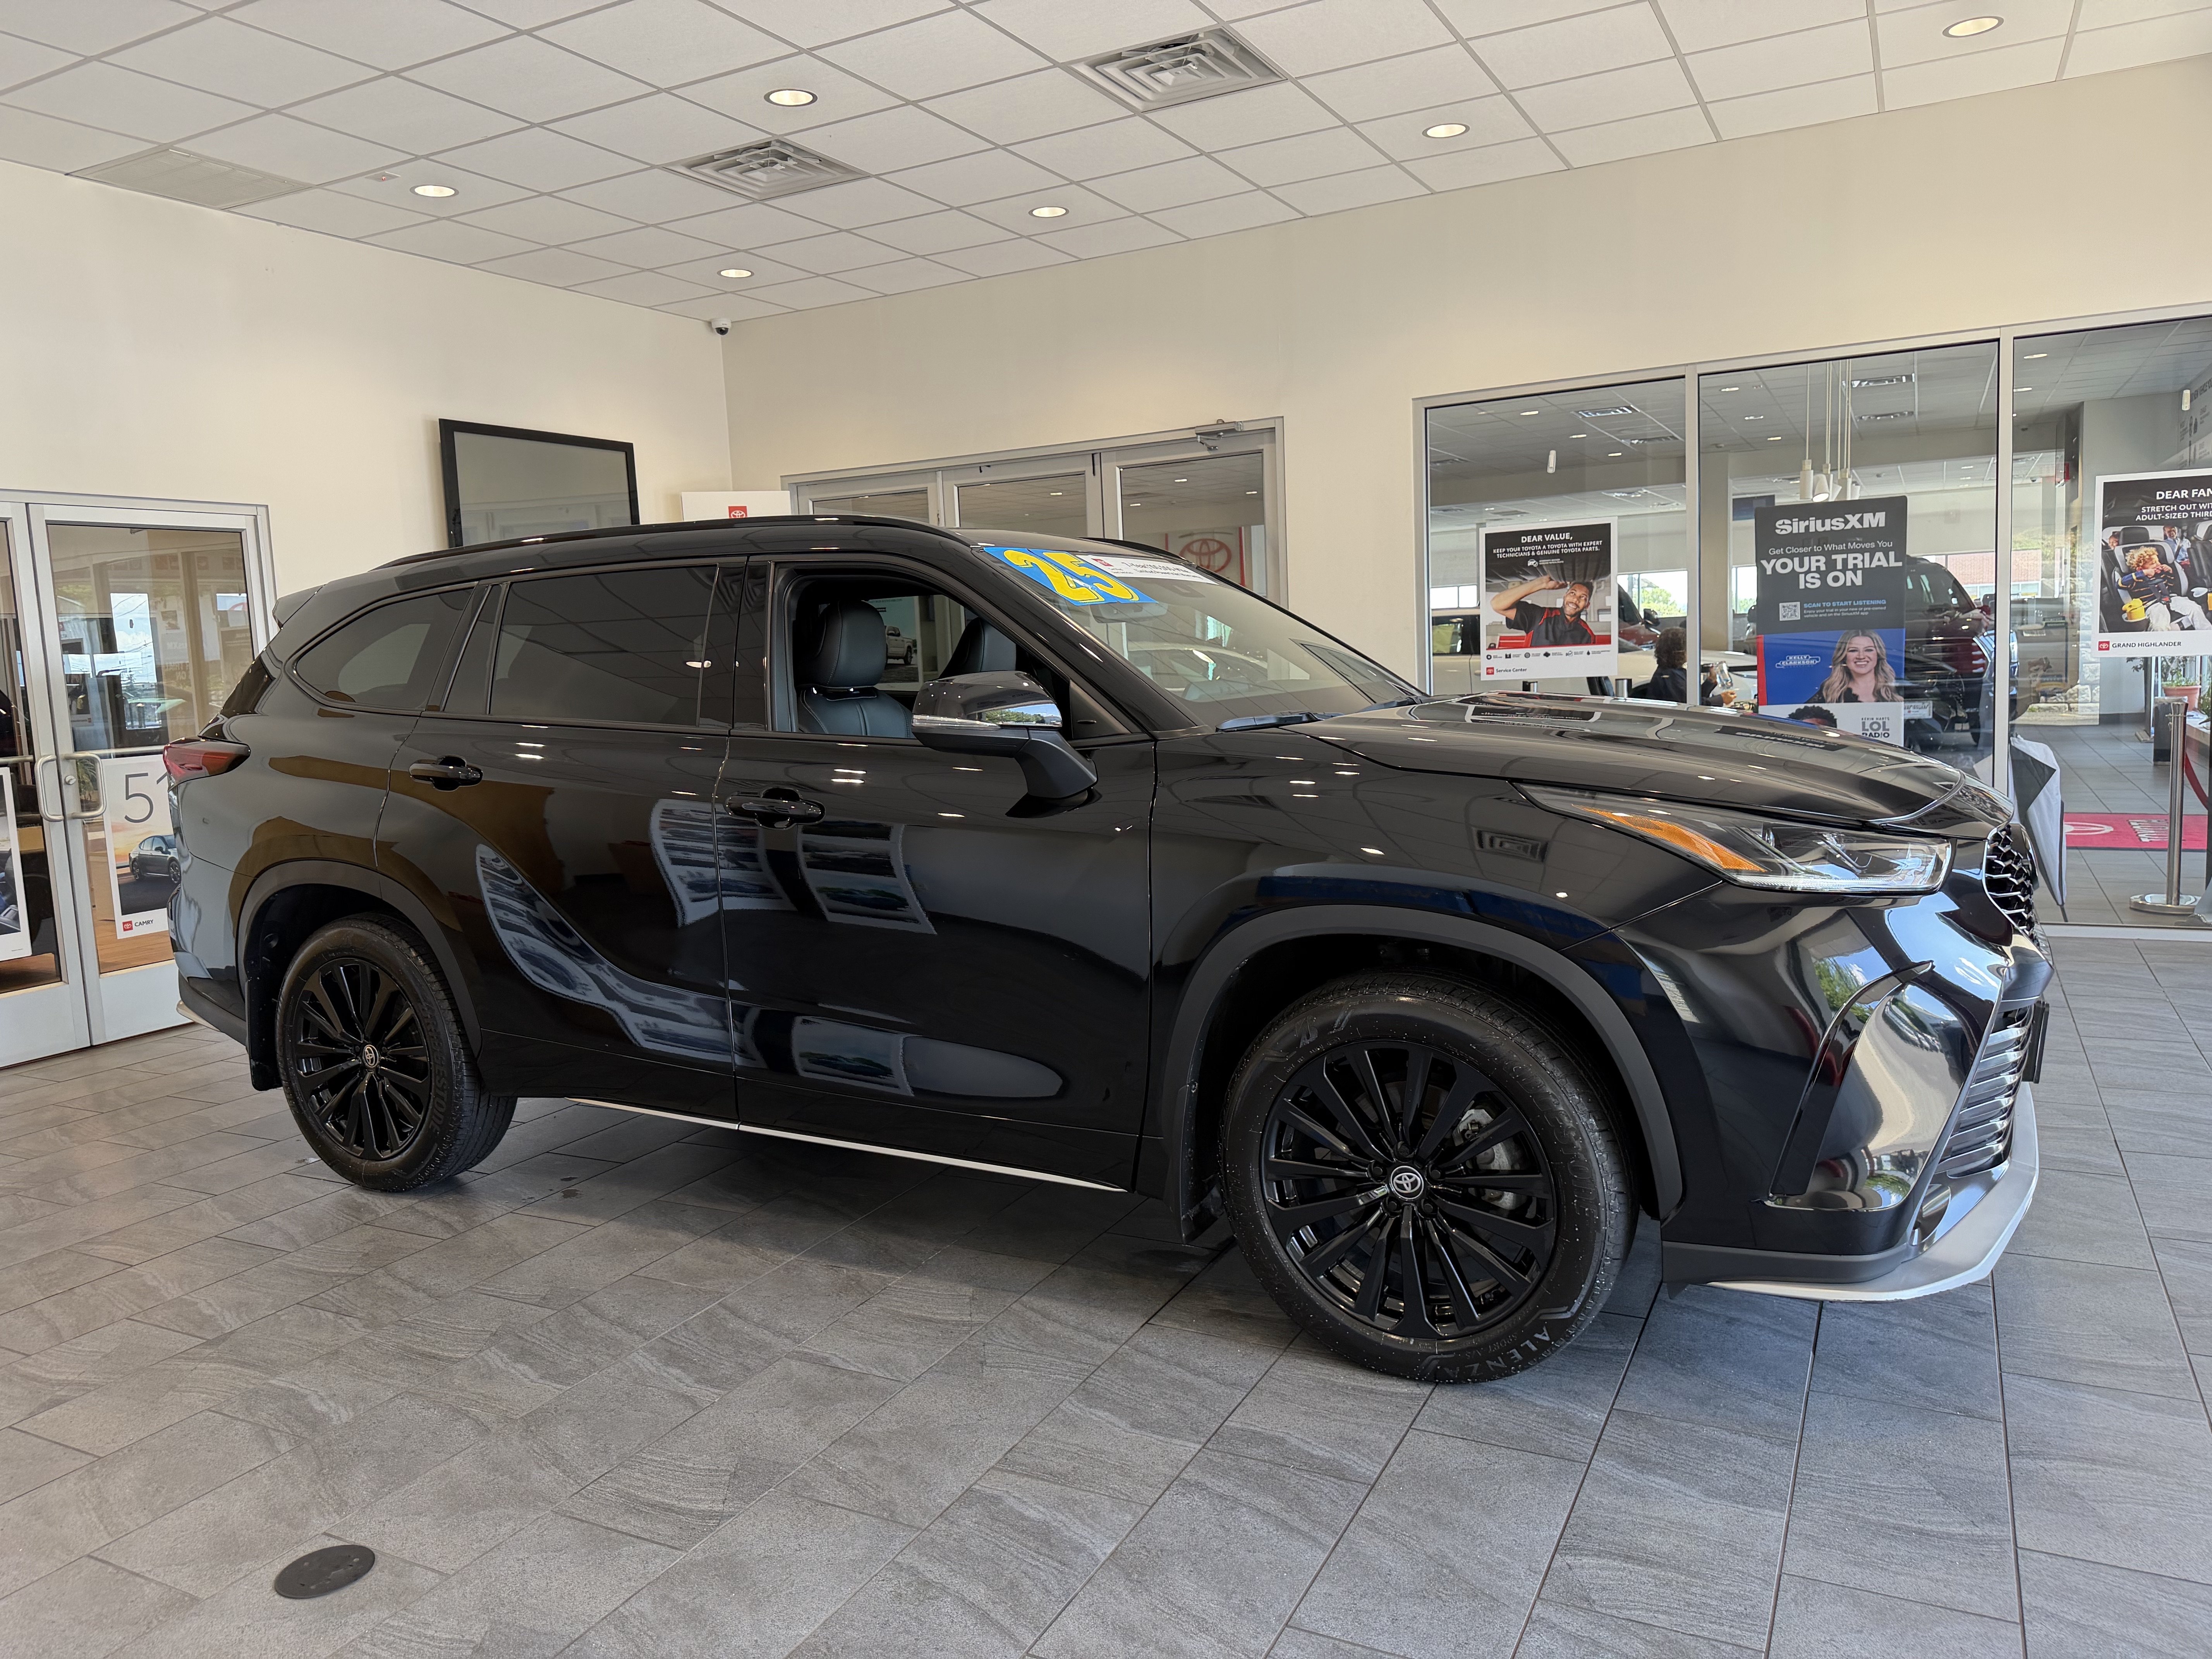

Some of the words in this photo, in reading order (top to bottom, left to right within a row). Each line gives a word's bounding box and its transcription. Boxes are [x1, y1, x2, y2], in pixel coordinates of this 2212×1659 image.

[2156, 490, 2188, 500] DEAR
[2142, 505, 2177, 513] STRETCH
[2135, 512, 2188, 521] ADULT-SIZED
[1775, 512, 1886, 534] SiriusXM
[1522, 534, 1542, 543] DEAR
[1545, 532, 1573, 541] VALUE,
[1786, 545, 1812, 554] Closer
[1824, 543, 1846, 551] What
[1848, 541, 1875, 550] Moves
[1760, 556, 1826, 575] YOUR
[1831, 551, 1903, 570] TRIAL
[1004, 550, 1139, 602] 25
[1799, 573, 1821, 589] IS
[1826, 570, 1863, 587] ON
[1862, 721, 1890, 732] LOL
[134, 919, 154, 927] CAMRY
[1443, 1325, 1551, 1378] ALENZA
